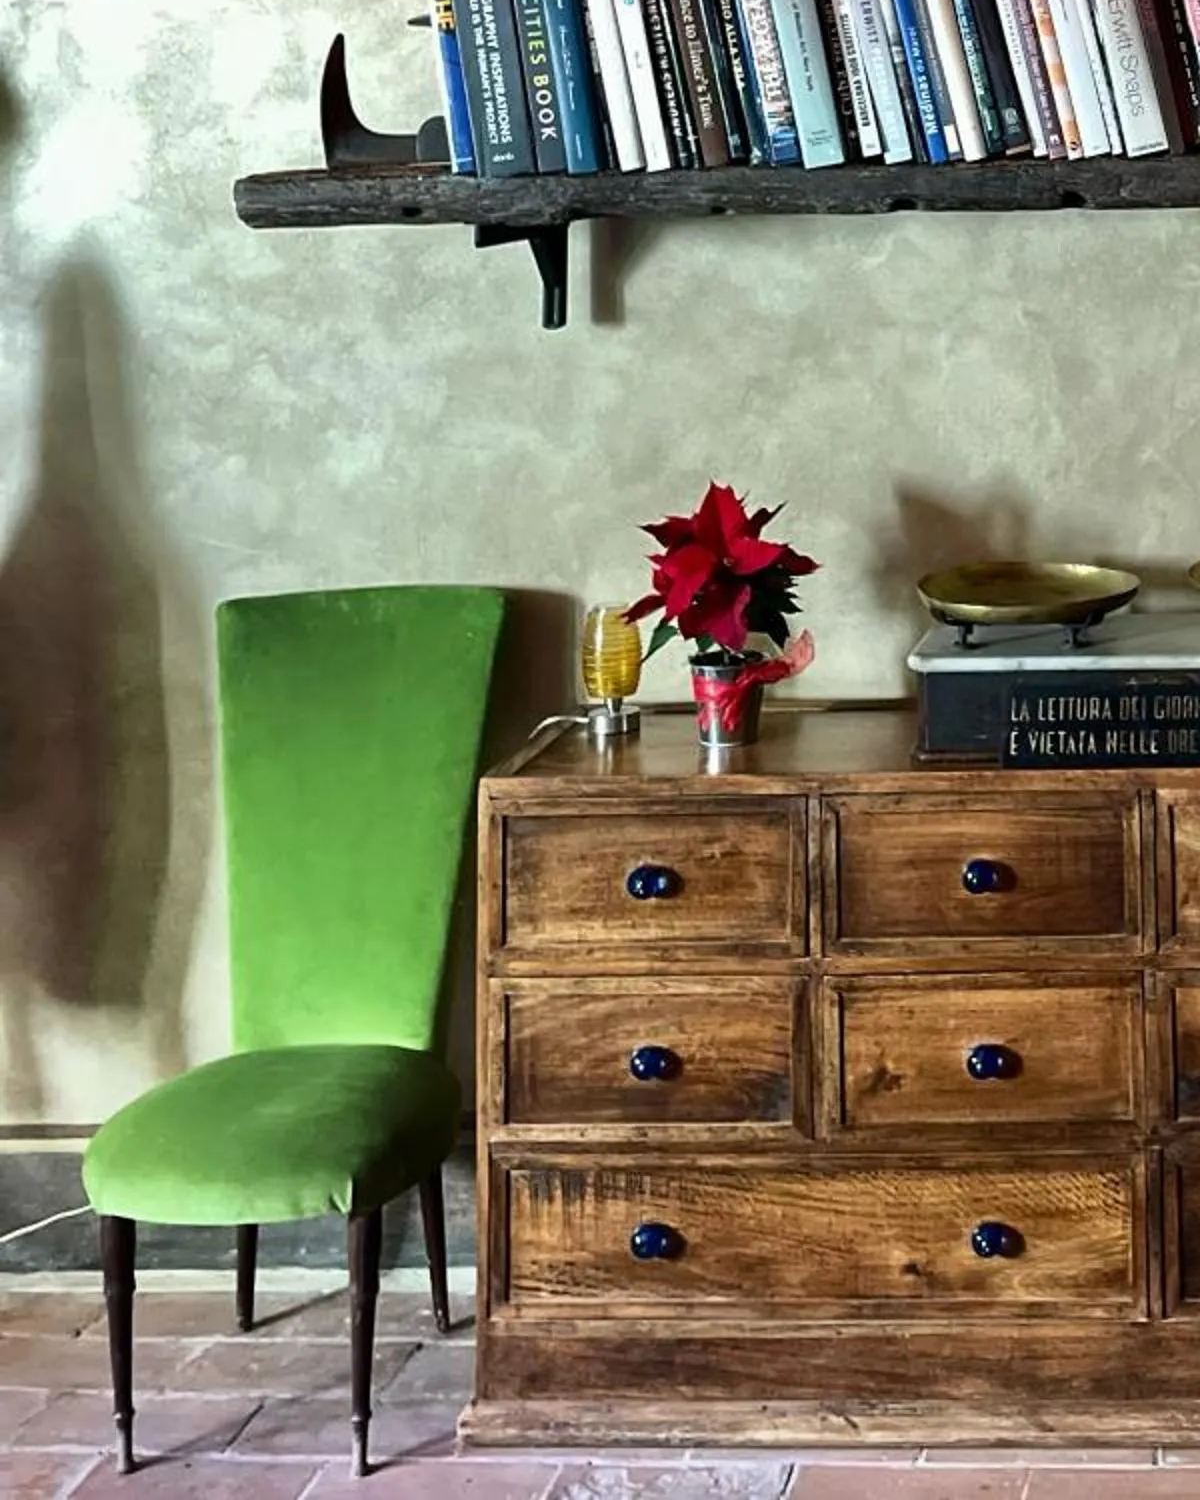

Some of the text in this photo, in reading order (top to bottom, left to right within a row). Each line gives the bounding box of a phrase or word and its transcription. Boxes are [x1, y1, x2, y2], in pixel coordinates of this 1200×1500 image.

[724, 21, 741, 56] ALLA
[859, 0, 881, 45] ERWITT
[472, 27, 484, 46] THE
[483, 100, 501, 146] PROJECT
[487, 51, 514, 144] INSPIRATIONS
[530, 73, 559, 141] BOOK
[659, 71, 684, 138] ANDREAS
[684, 24, 698, 39] to
[697, 94, 718, 131] Tune
[758, 58, 784, 100] THE
[1113, 53, 1151, 120] Snaps
[1011, 699, 1031, 721] LA
[1038, 697, 1113, 721] LETTURA
[1119, 696, 1147, 720] DEI
[1028, 729, 1097, 755] VIETATA
[1107, 728, 1159, 755] NELLE
[1167, 728, 1199, 754] ORE
